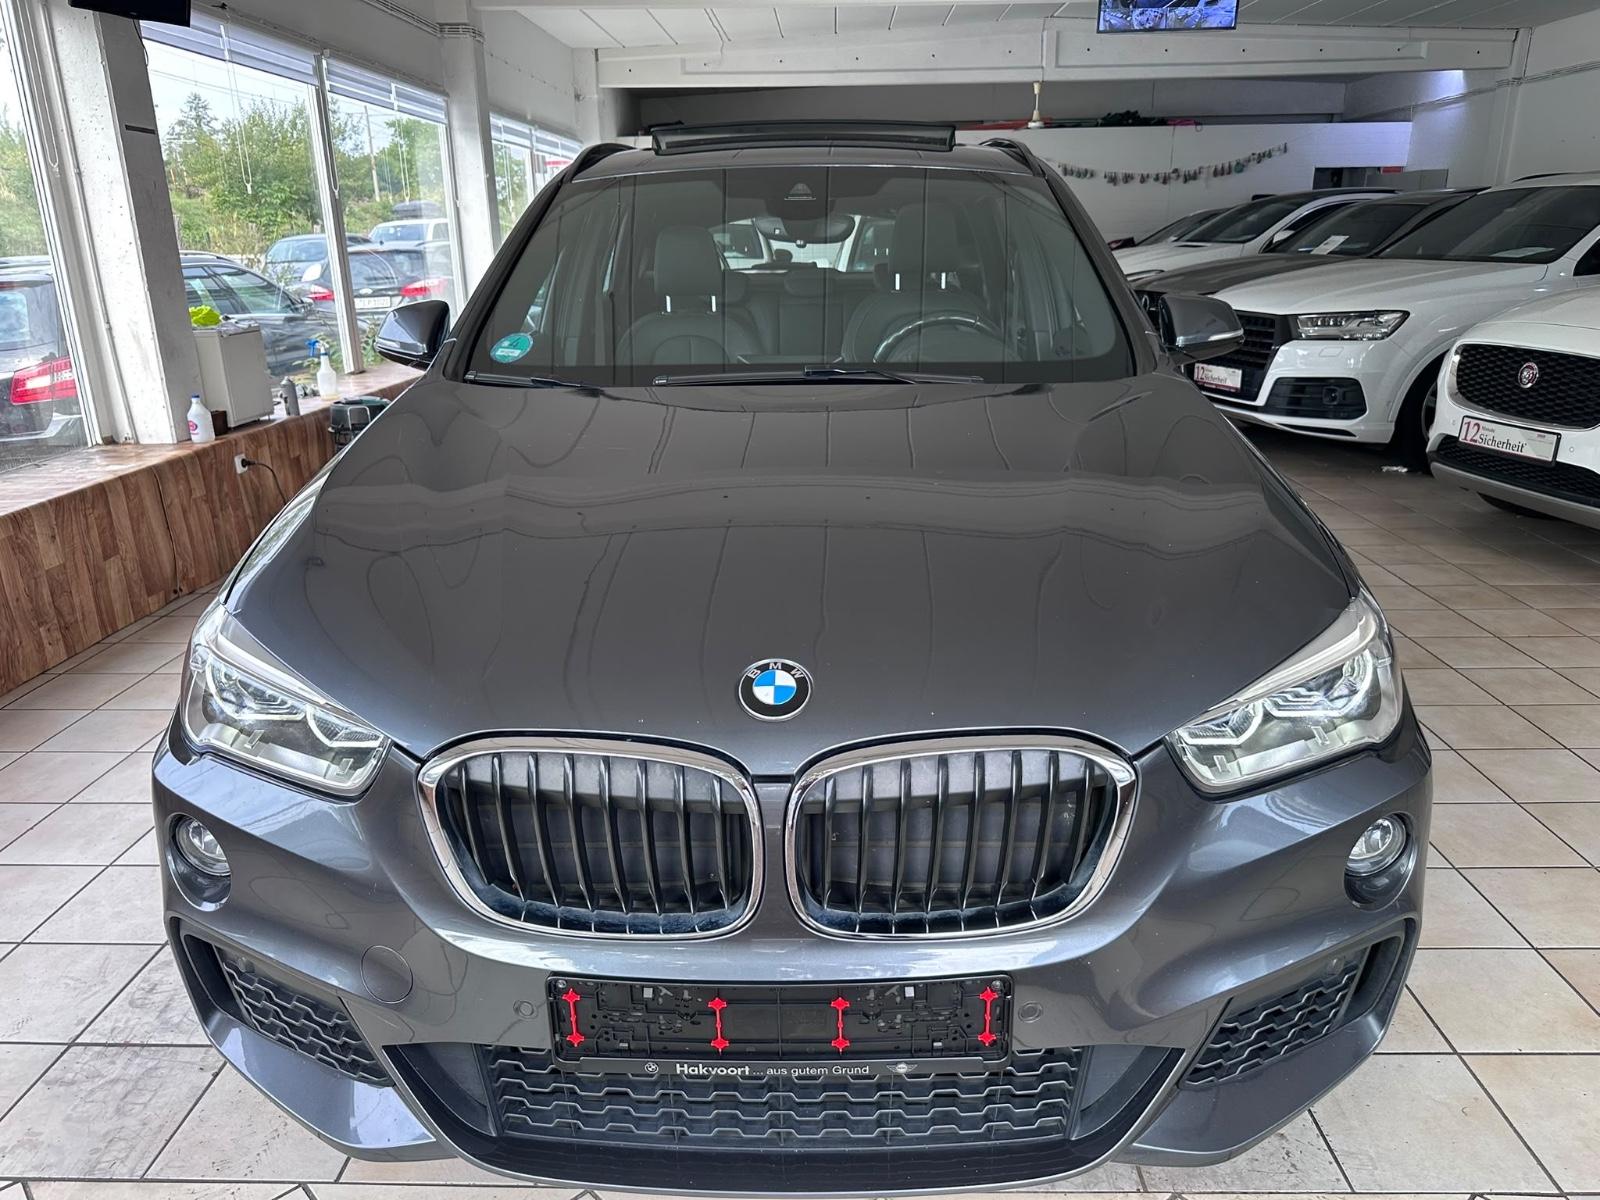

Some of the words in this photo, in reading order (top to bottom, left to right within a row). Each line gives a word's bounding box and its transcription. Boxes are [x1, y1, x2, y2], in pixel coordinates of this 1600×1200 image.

[1195, 365, 1205, 381] 12
[1461, 420, 1481, 444] 12
[1479, 433, 1526, 453] Sicherheit
[746, 662, 805, 679] BMW
[675, 1063, 750, 1076] Hakvoort
[766, 1066, 788, 1076] aus
[791, 1065, 829, 1077] gutem
[832, 1065, 870, 1075] Grund
